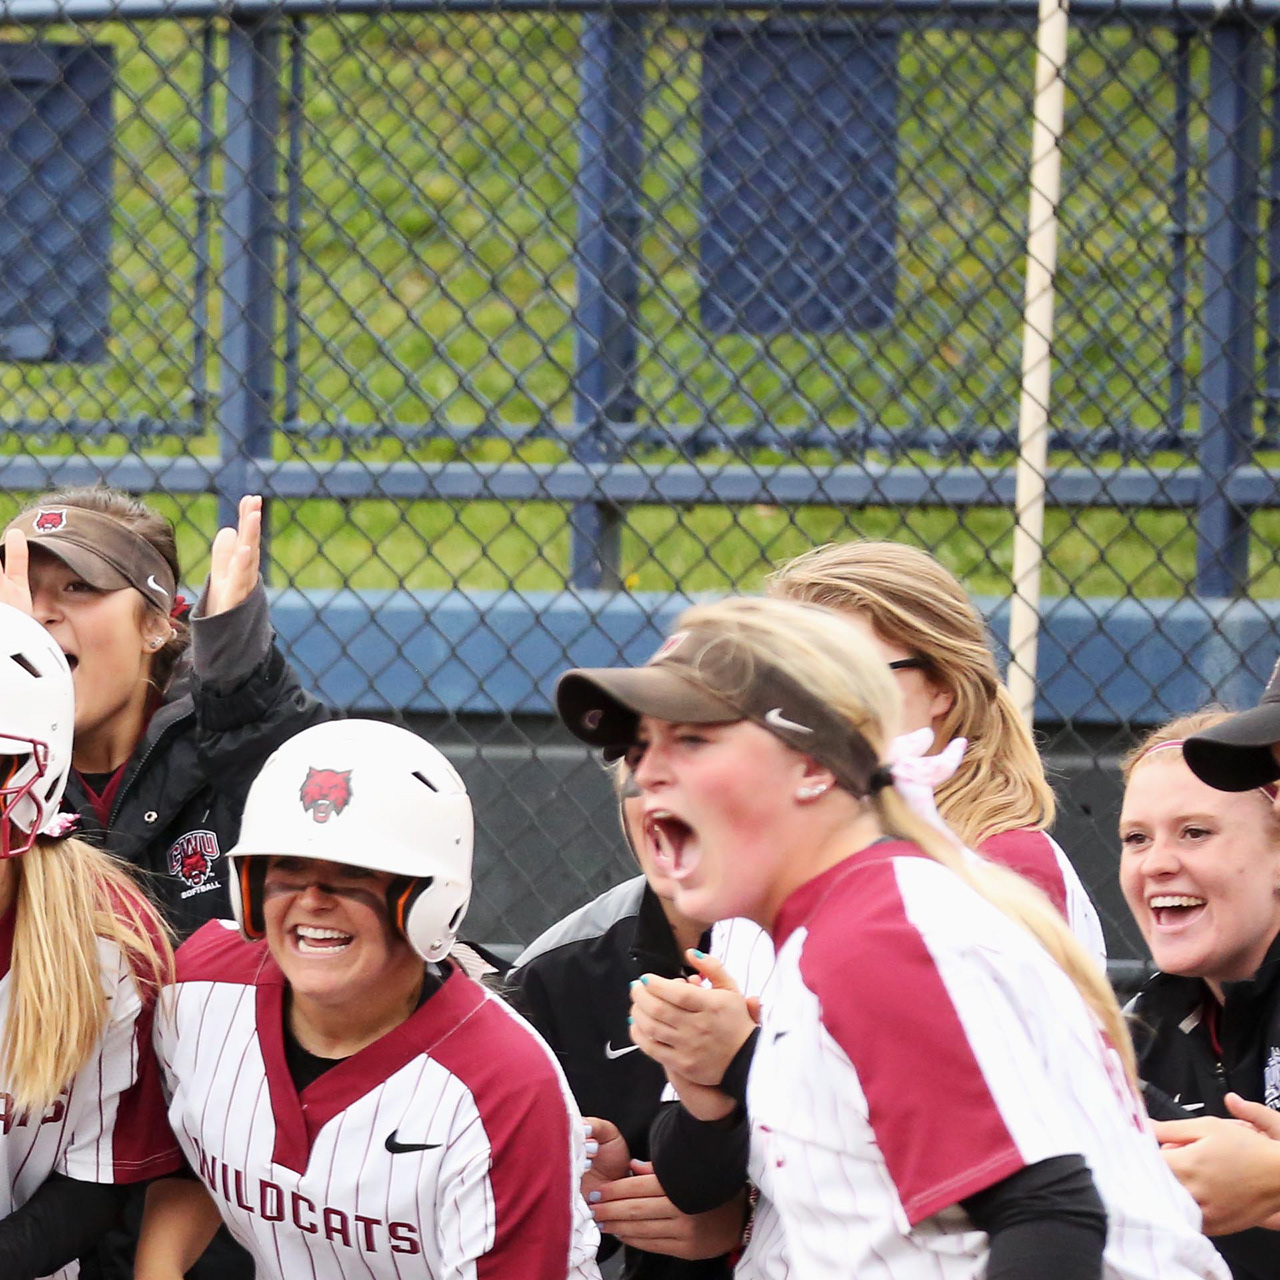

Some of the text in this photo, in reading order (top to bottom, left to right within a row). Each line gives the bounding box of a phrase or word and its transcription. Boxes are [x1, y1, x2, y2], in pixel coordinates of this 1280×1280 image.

[167, 831, 220, 874] CWU
[180, 881, 221, 899] SOFTBALL
[193, 1137, 420, 1255] WILDCATS
